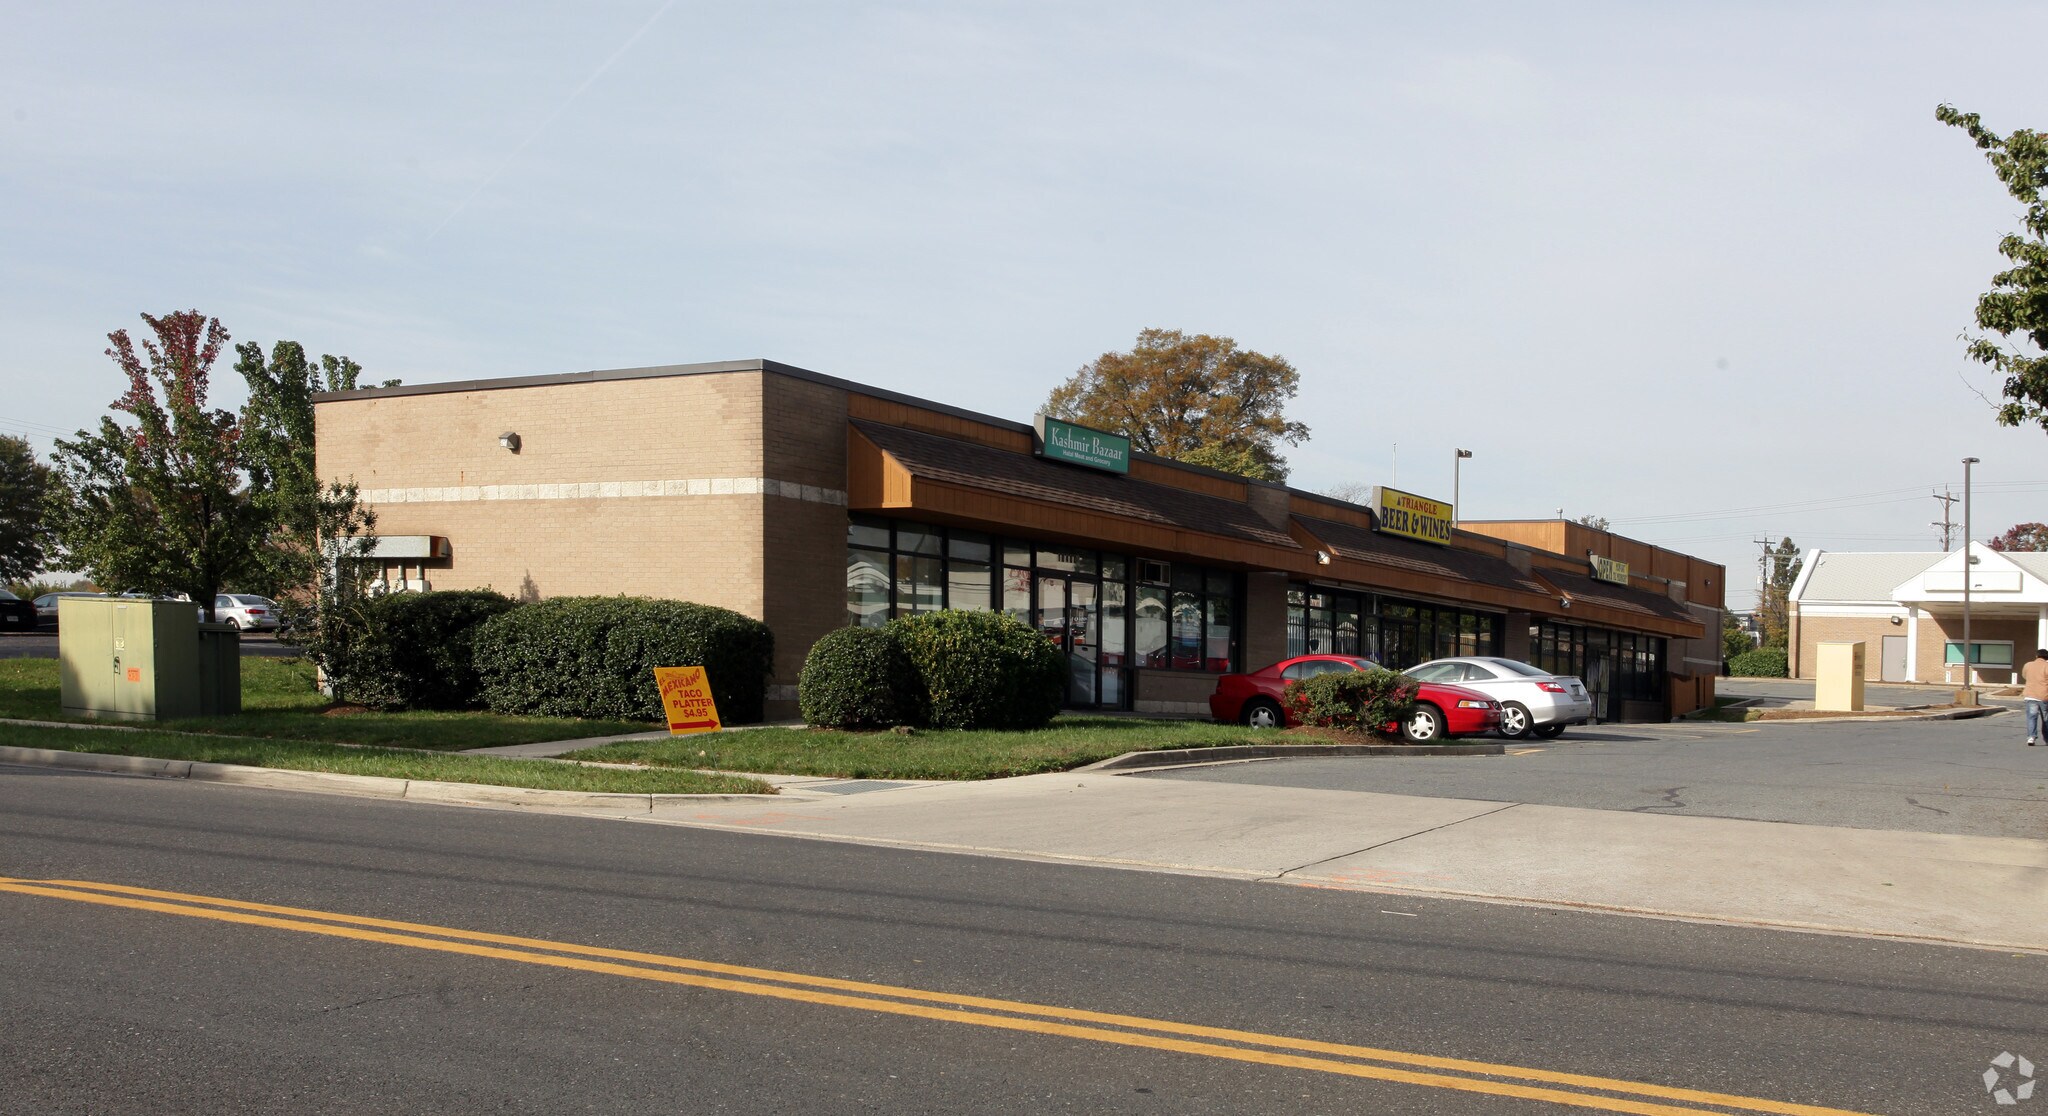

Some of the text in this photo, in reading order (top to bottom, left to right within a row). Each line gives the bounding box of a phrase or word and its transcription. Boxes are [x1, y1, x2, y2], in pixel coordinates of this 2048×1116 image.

[1051, 427, 1123, 460] Kashmir Bazaar
[1402, 496, 1437, 515] TRIANGLE
[1382, 506, 1450, 541] BEER & WINES
[1599, 558, 1613, 580] OPEN
[672, 698, 713, 708] PLATTER
[677, 689, 702, 698] TACO
[683, 708, 708, 718] $4.95
